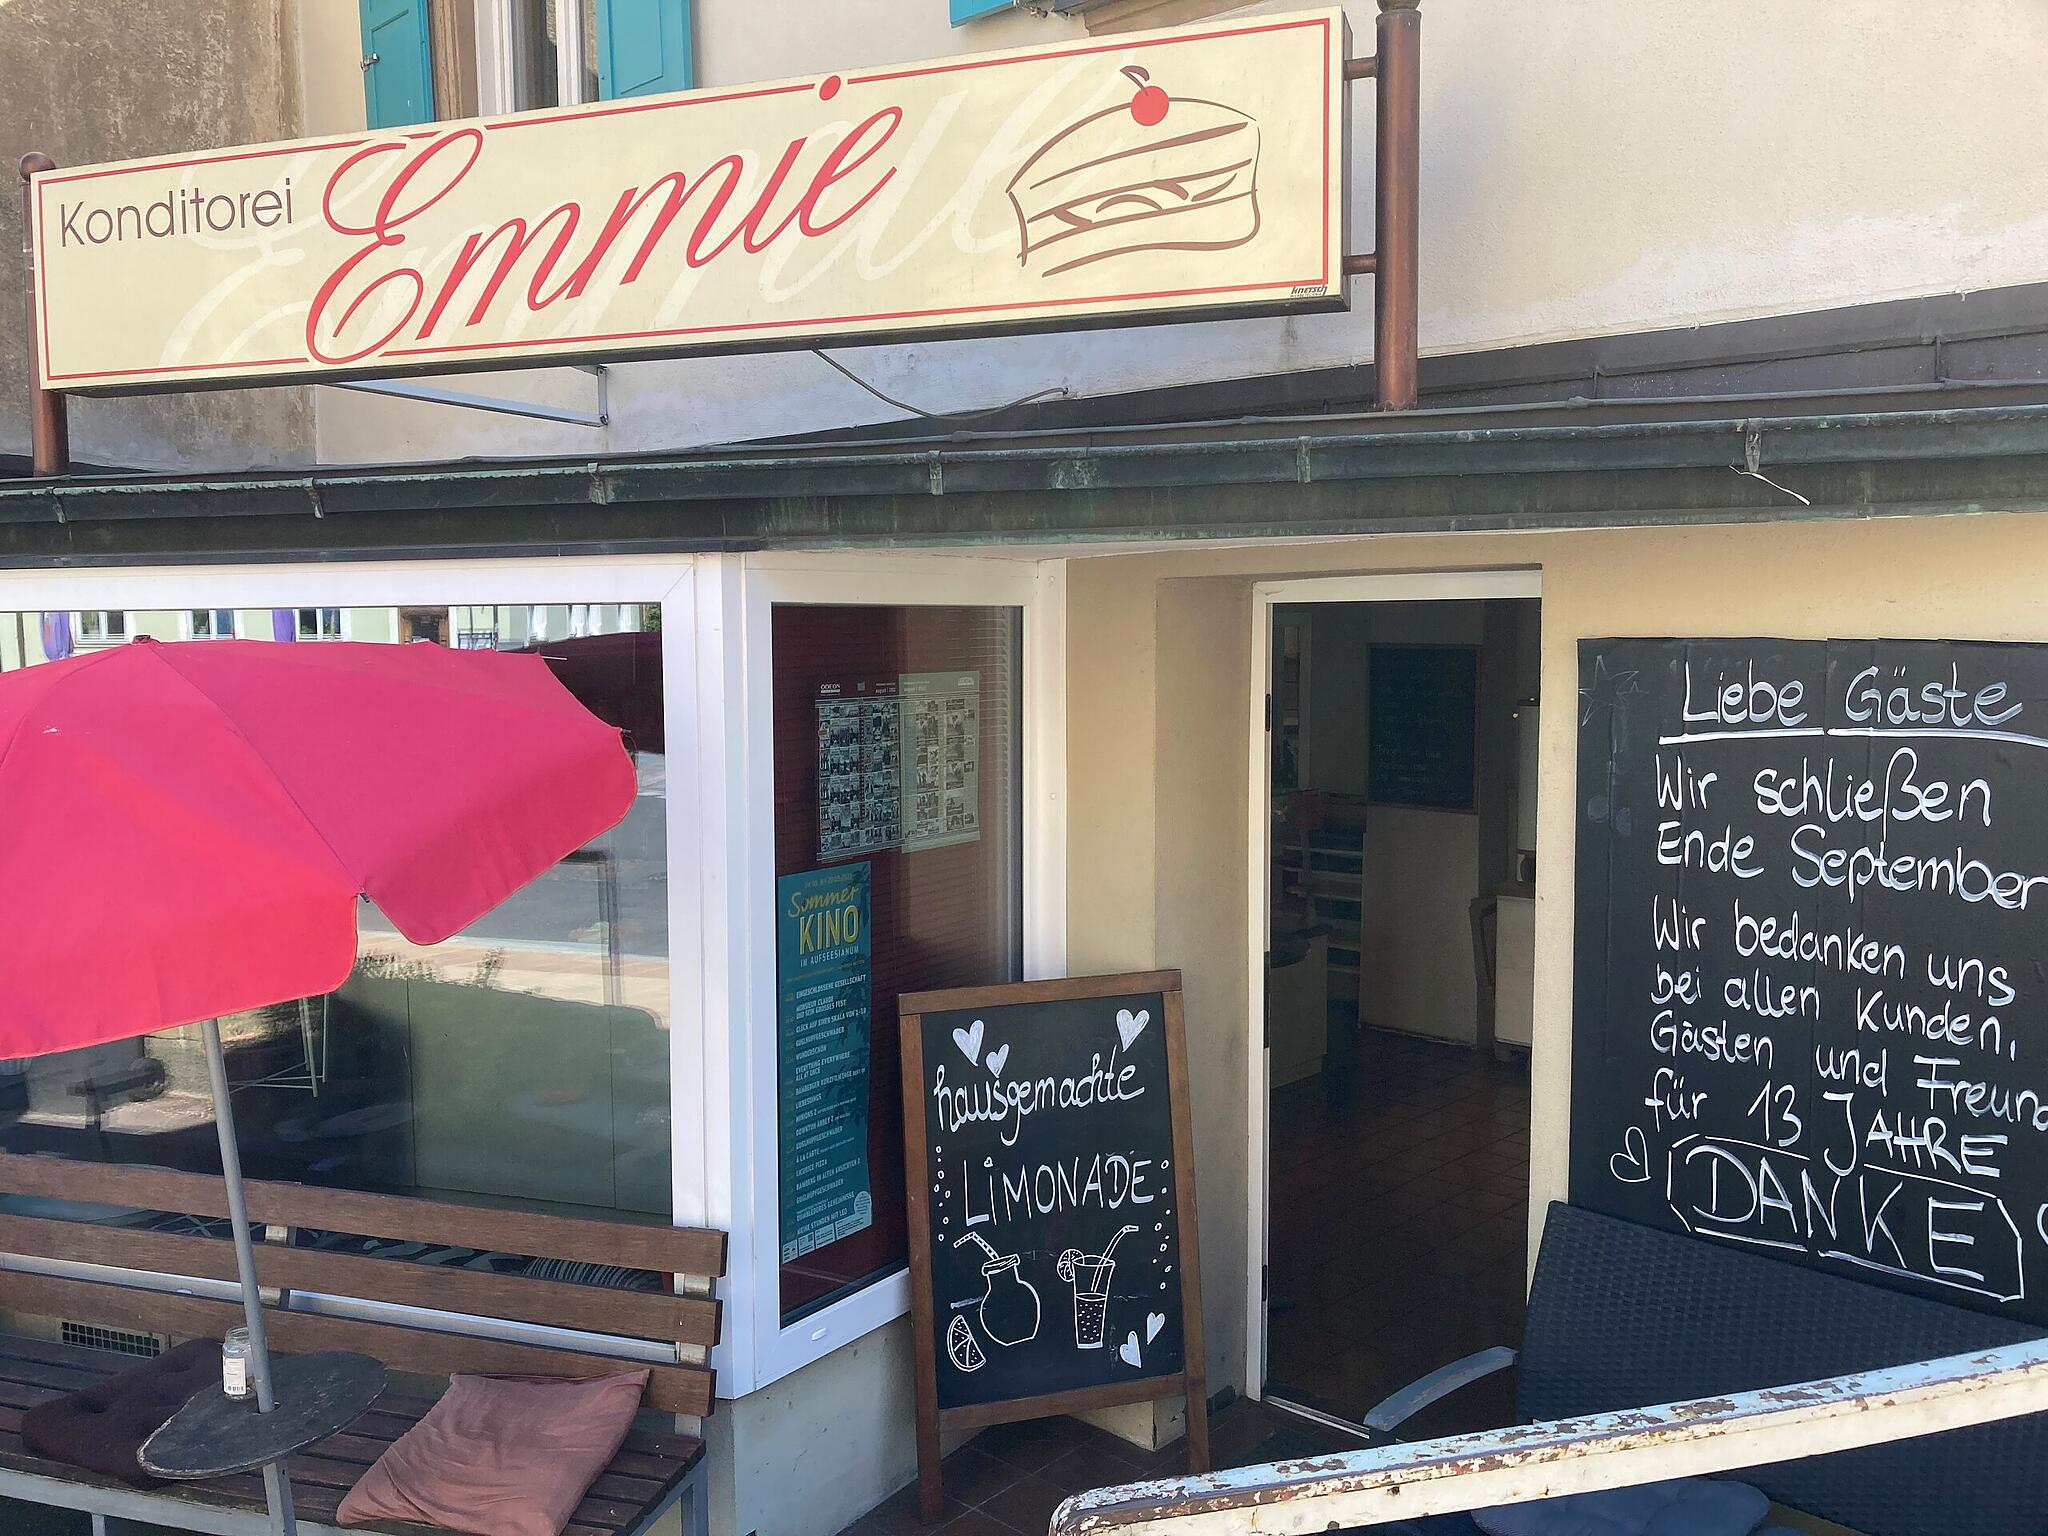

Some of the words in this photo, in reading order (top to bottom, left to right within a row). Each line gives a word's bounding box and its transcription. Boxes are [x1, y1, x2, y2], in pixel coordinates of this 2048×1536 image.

[59, 177, 293, 249] Konditorei
[306, 74, 903, 364] Emmie
[1682, 659, 1808, 727] Liebe
[1844, 661, 2024, 727] Gäste
[1655, 753, 1718, 811] Wir
[1753, 746, 1991, 841] schließen
[788, 886, 860, 918] Sommer
[1656, 820, 1764, 879] Ende
[1790, 823, 2048, 910] September
[799, 905, 859, 955] KINO
[810, 946, 859, 966] AUFSEESIANUM
[1653, 894, 1706, 952] Wir
[1734, 898, 1905, 979] bedanken
[1927, 952, 2015, 1007] uns
[1650, 1009, 1773, 1070] Gästen
[1815, 1043, 1887, 1096] und
[1651, 961, 1701, 1005] bei
[1724, 967, 1820, 1020] allen
[1856, 987, 2017, 1061] Kunden,
[933, 1044, 1145, 1146] hausgemachte
[1645, 1067, 1708, 1132] für
[1747, 1080, 1803, 1147] 13
[1823, 1091, 2008, 1177] JAHRE
[1686, 1144, 1985, 1282] DANKE
